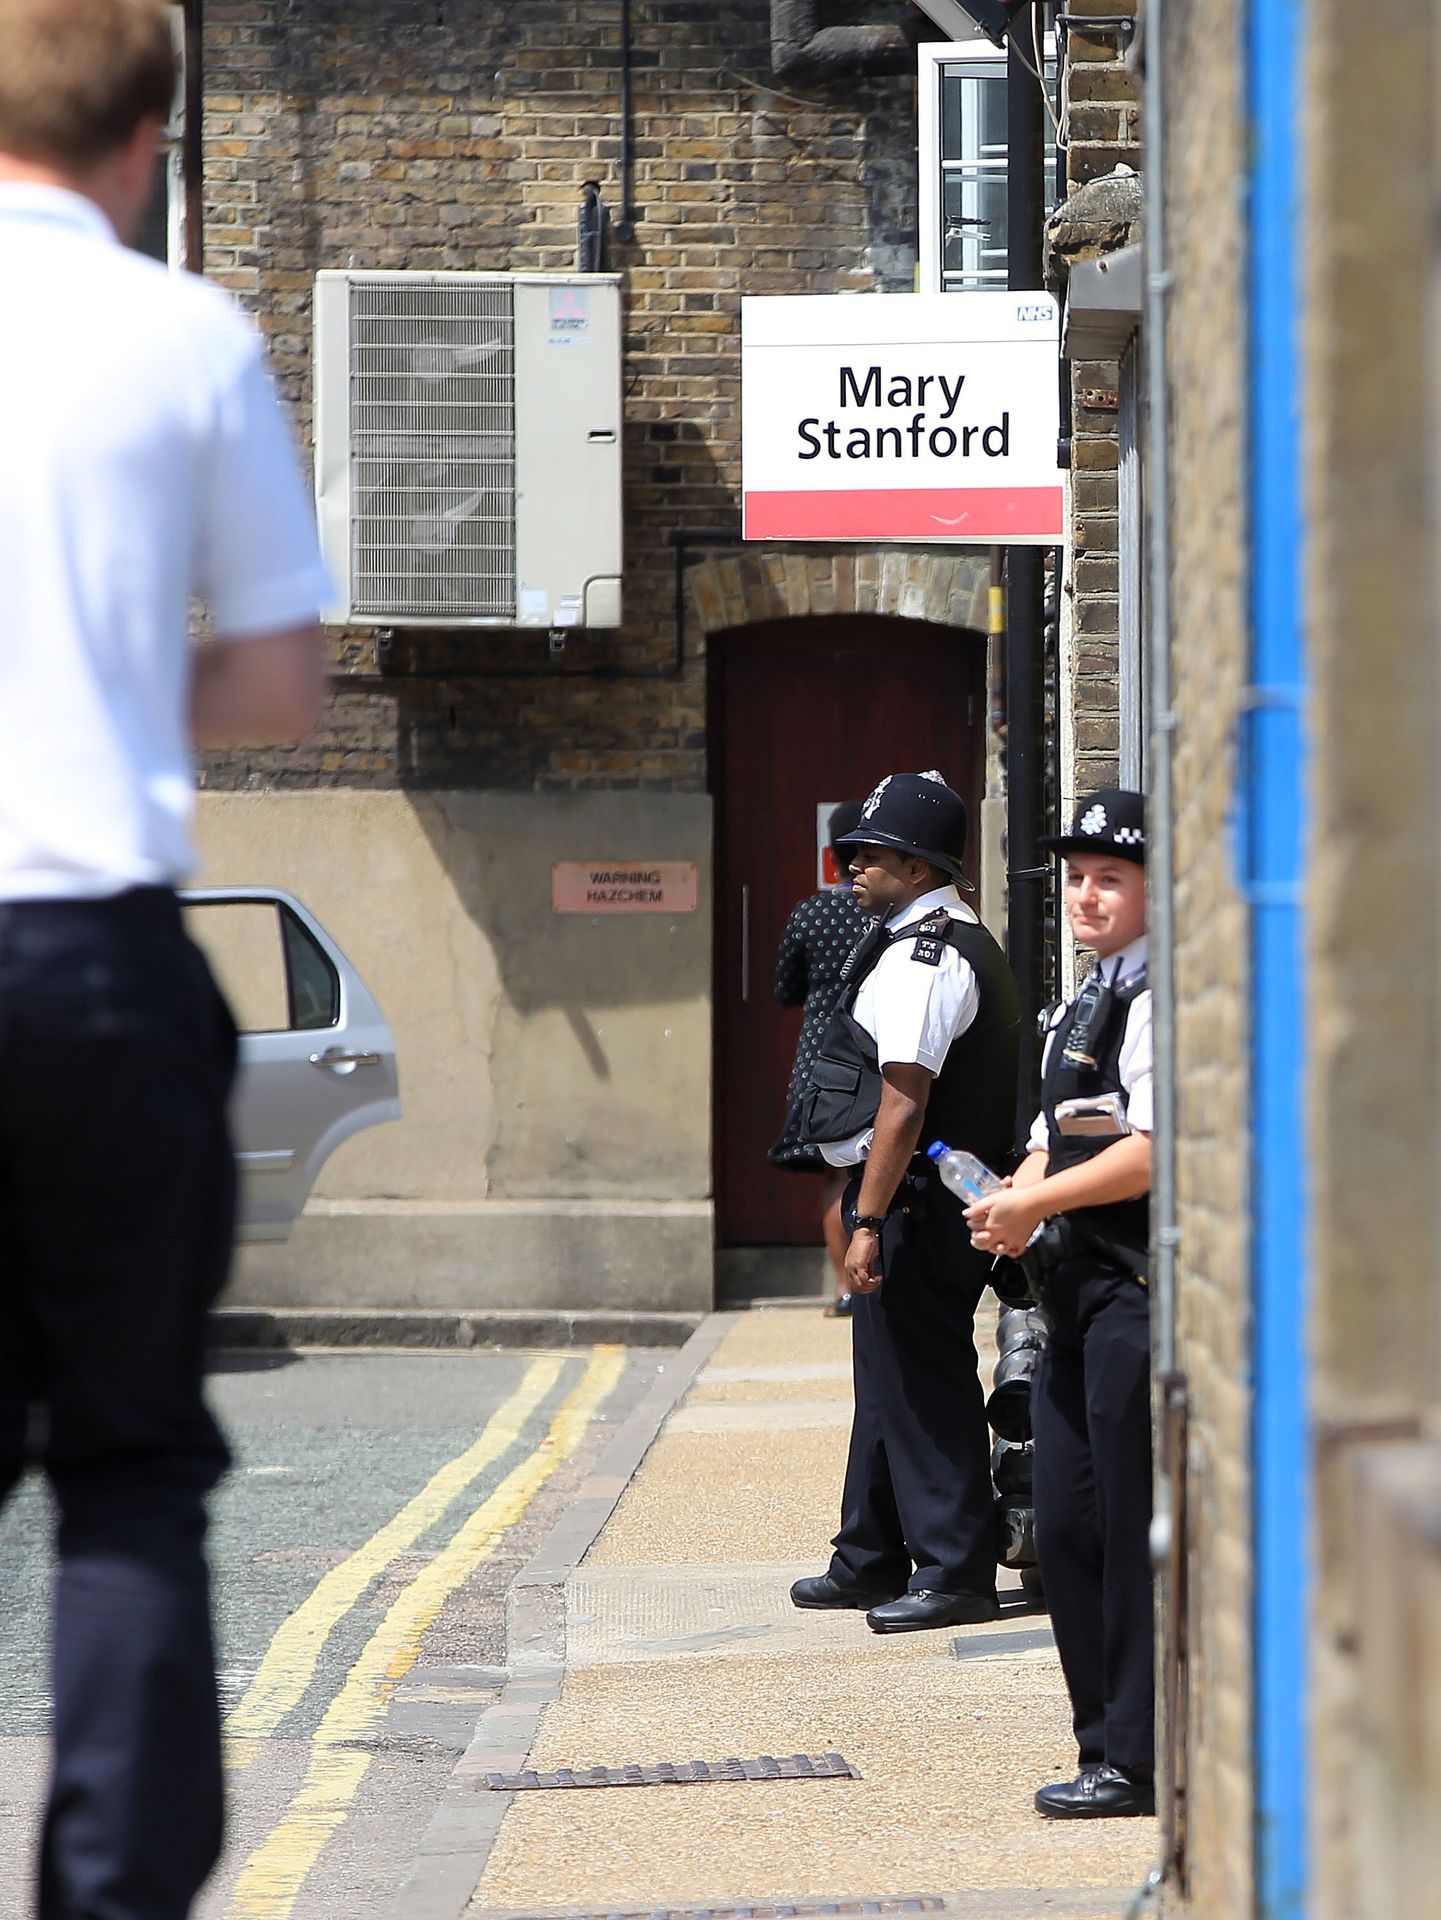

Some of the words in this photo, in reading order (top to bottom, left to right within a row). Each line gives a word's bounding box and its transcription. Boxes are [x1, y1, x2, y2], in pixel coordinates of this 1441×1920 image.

[1017, 306, 1052, 321] NHS
[839, 366, 966, 418] Mary
[797, 412, 1010, 460] Stanford
[590, 871, 662, 884] WARNING
[587, 889, 664, 902] HAZCHEM
